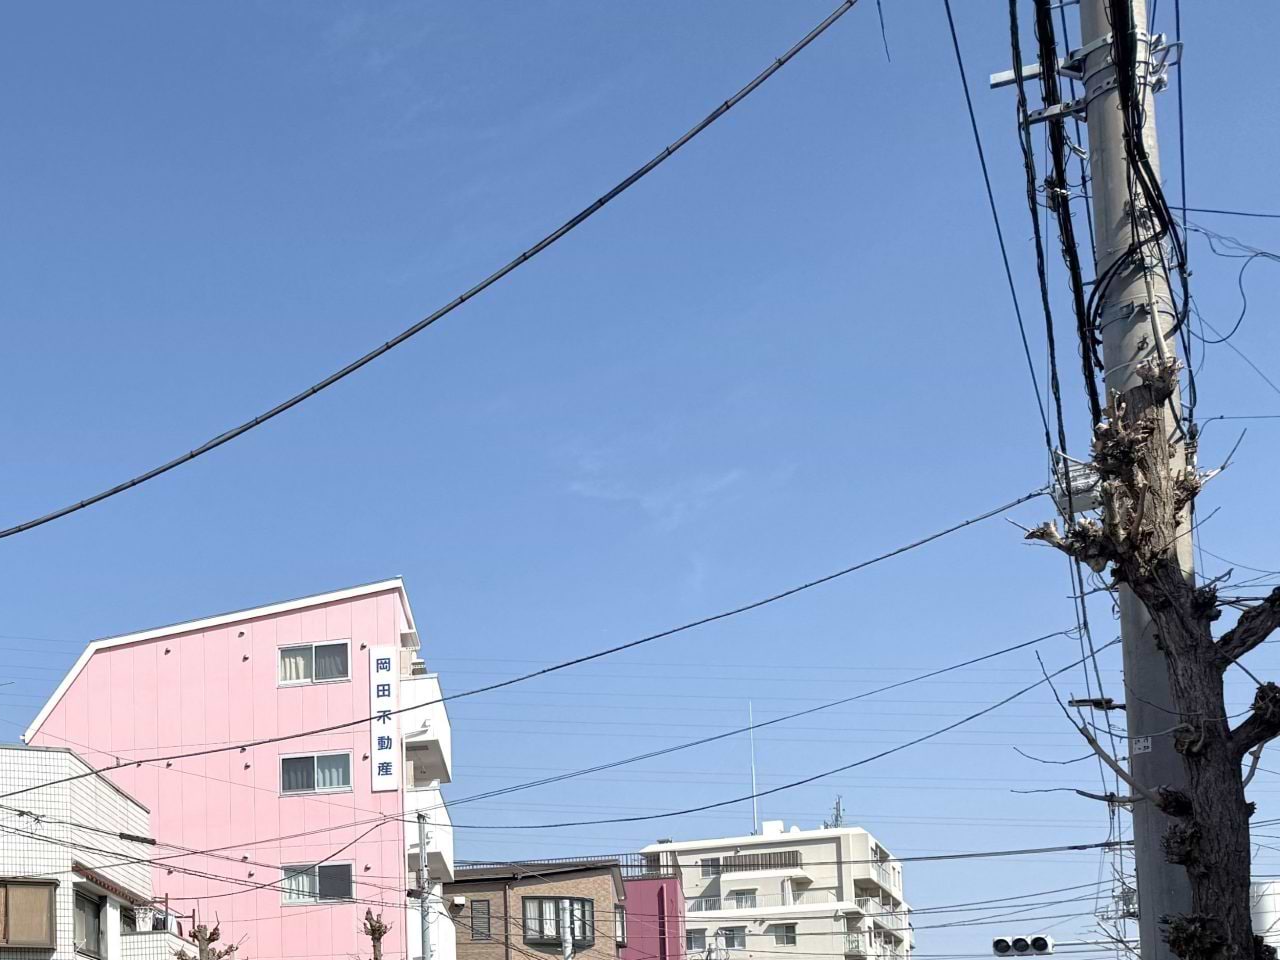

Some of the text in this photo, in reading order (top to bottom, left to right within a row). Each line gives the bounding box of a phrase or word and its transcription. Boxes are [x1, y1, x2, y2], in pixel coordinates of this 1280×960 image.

[376, 658, 392, 776] 岡田不動産
